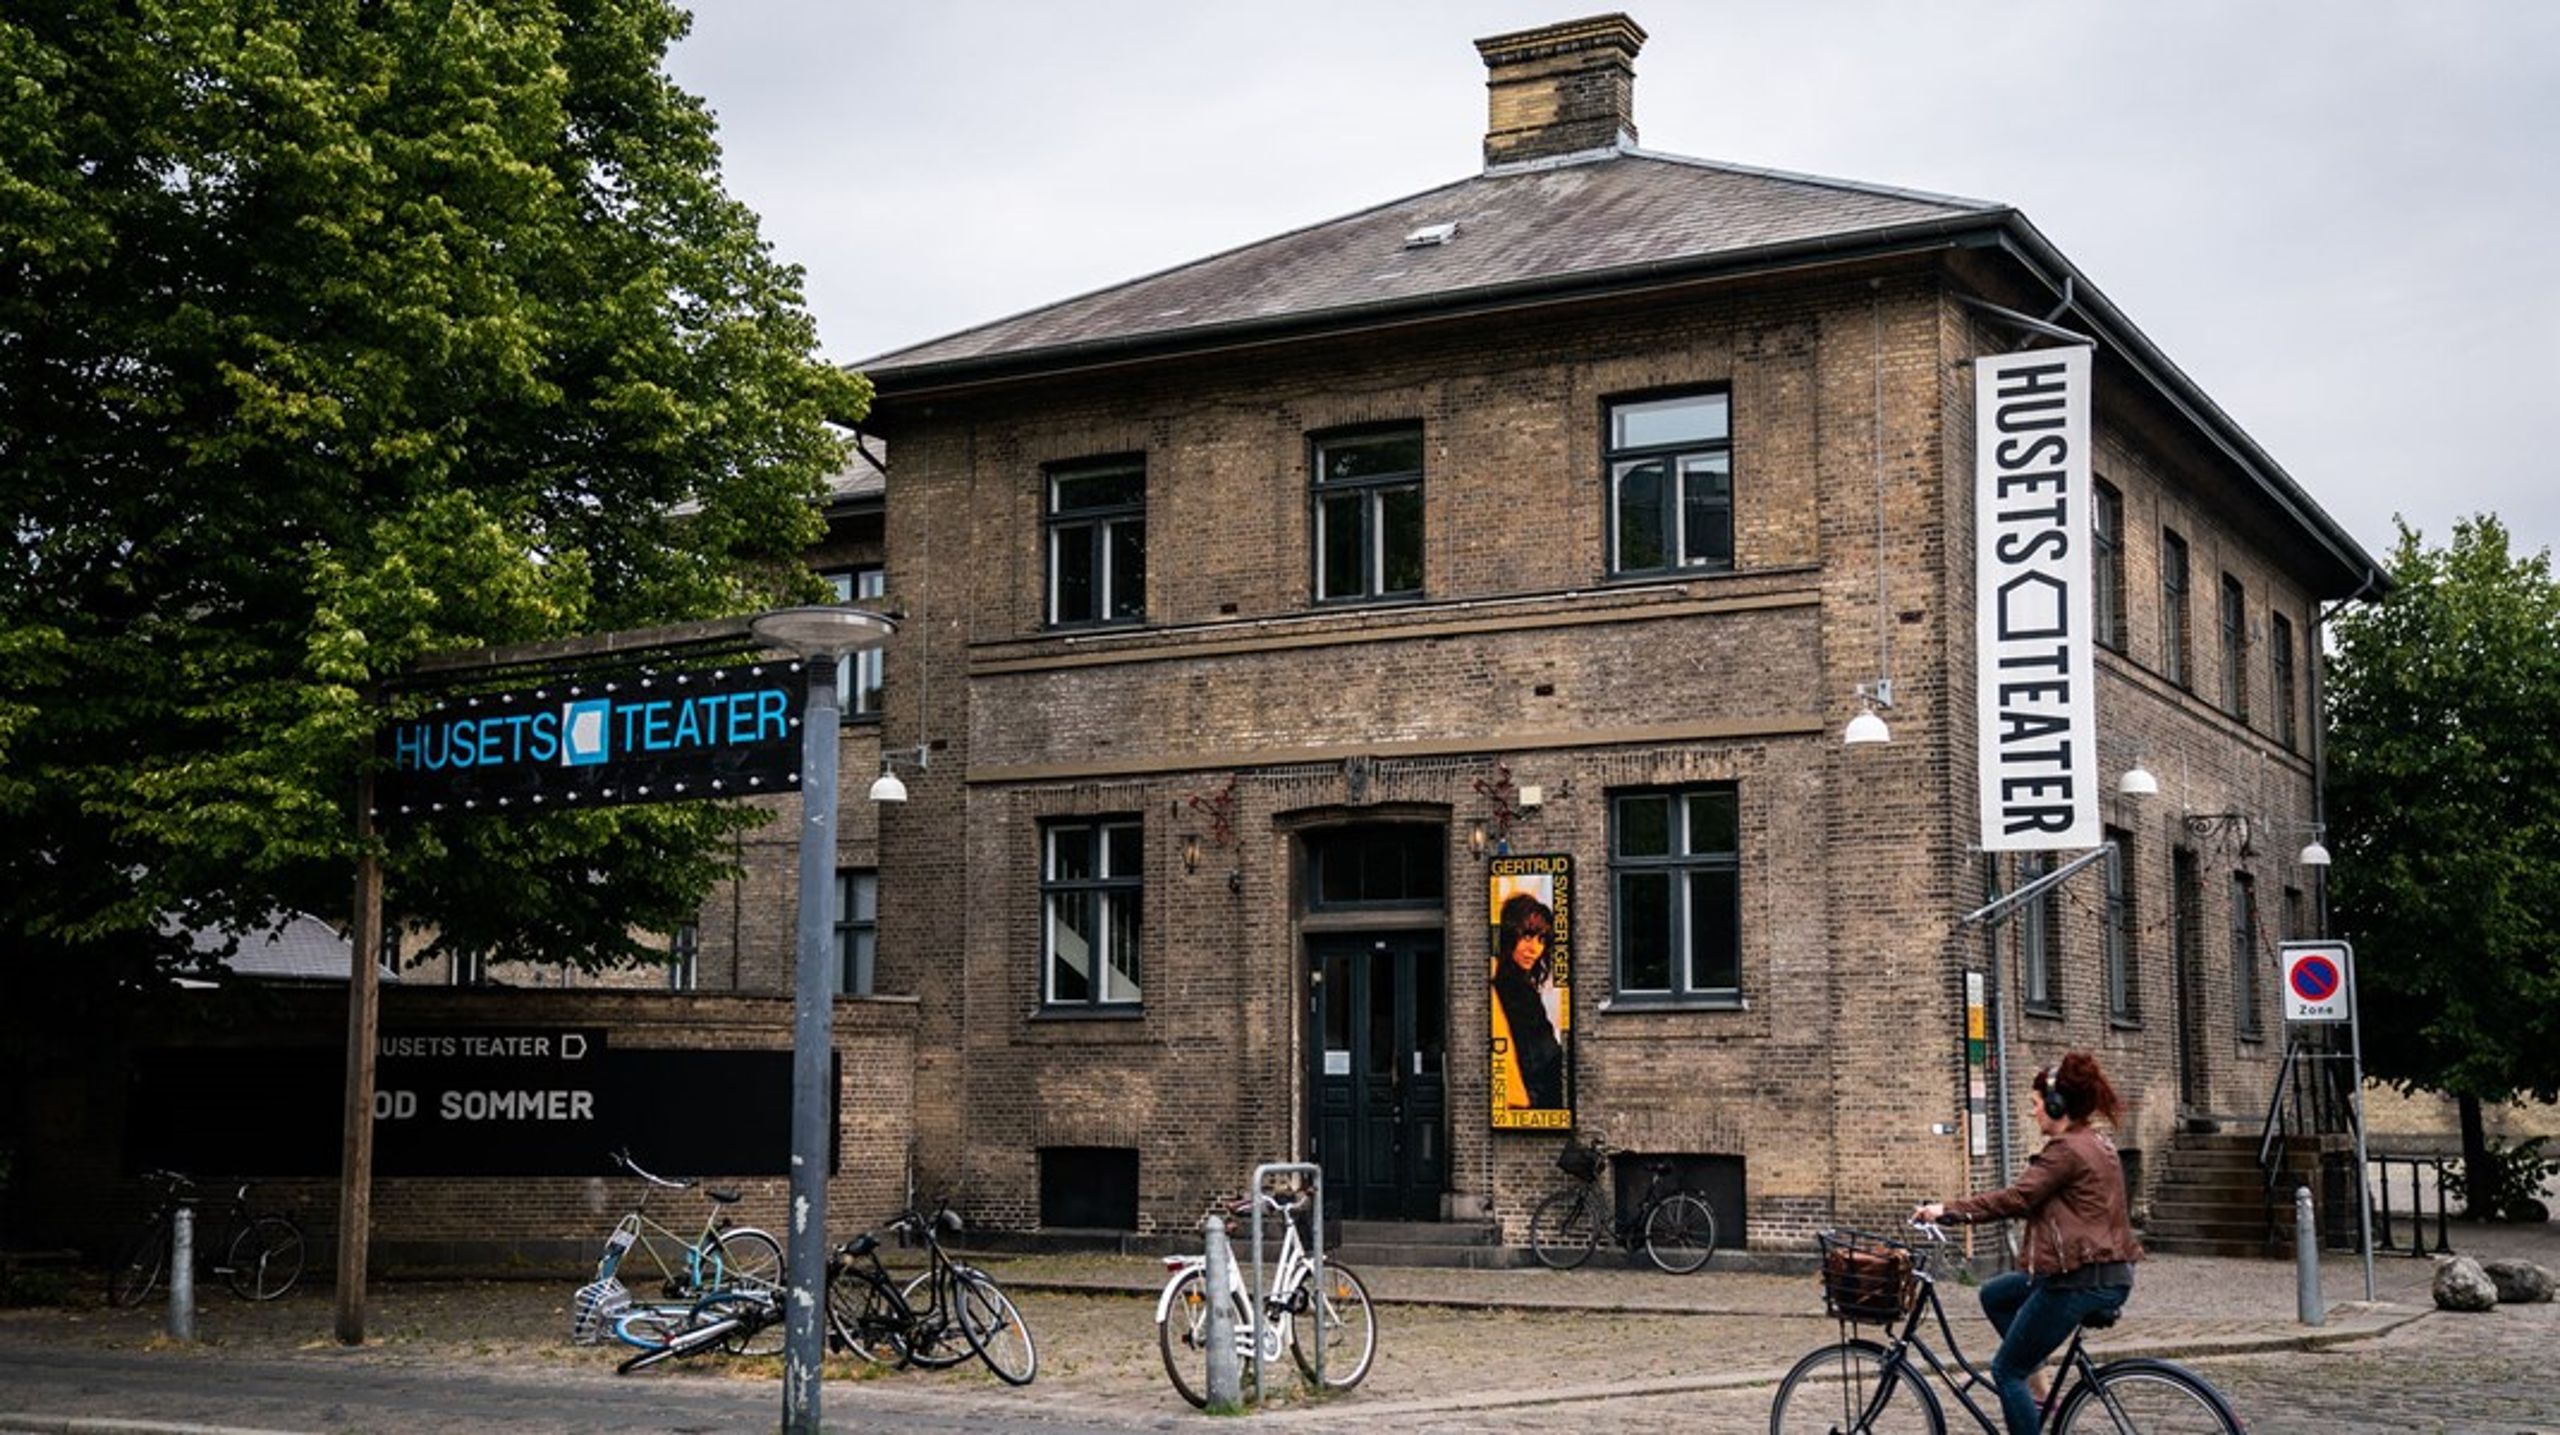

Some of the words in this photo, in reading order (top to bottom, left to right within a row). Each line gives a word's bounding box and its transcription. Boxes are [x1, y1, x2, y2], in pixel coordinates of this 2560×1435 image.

[1995, 362, 2069, 565] HUSETS
[396, 712, 558, 771] HUSETS
[616, 690, 788, 752] TEATER
[1998, 645, 2075, 836] TEATER
[1491, 857, 1569, 875] GERTRUD
[1554, 945, 1569, 987] IGEN
[2298, 1004, 2333, 1015] Zone
[375, 1036, 457, 1056] USETS
[462, 1036, 550, 1056] TEATER
[373, 1090, 417, 1120] OD
[440, 1090, 594, 1120] SOMMER
[1509, 1111, 1569, 1126] TEATER
